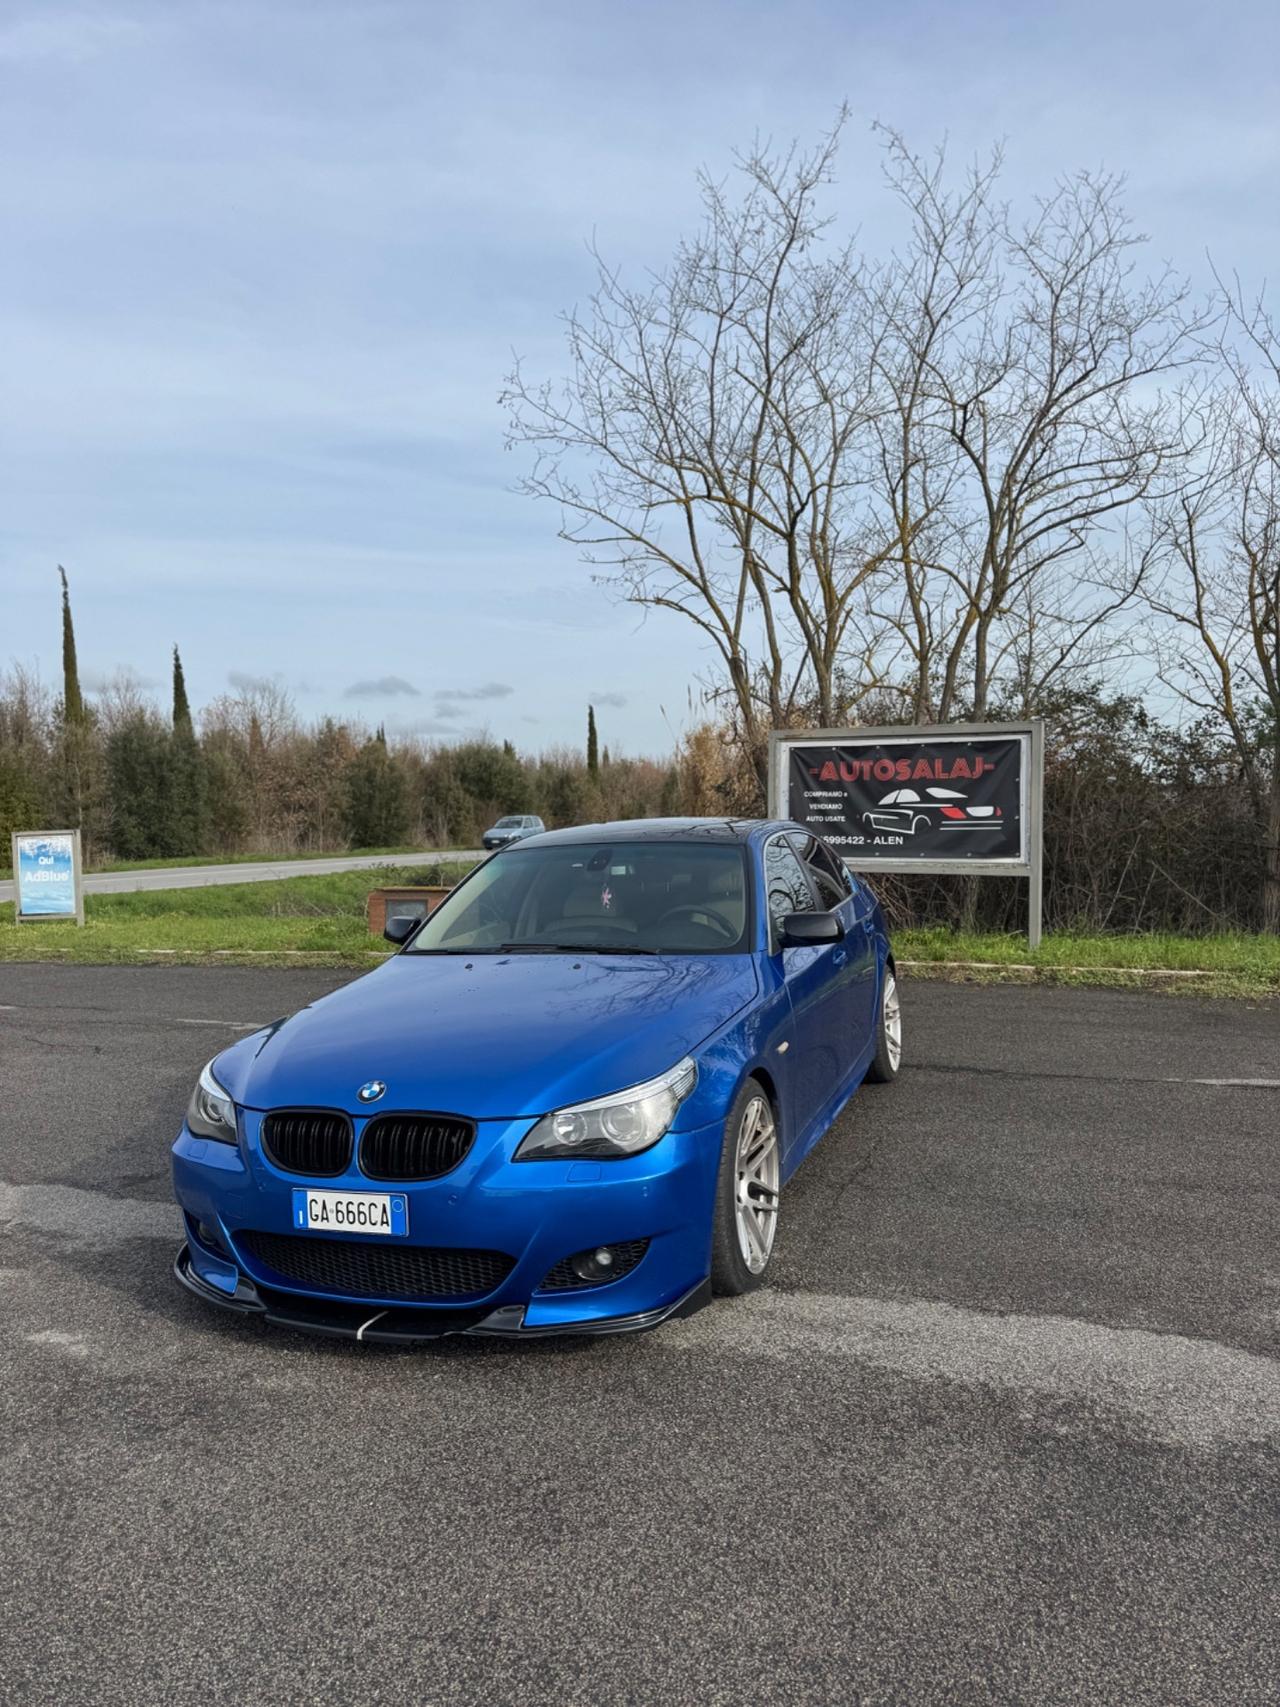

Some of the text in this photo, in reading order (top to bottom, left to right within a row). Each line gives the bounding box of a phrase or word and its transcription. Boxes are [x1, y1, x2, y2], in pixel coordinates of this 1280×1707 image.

[803, 790, 842, 798] COMPRIAMO
[873, 836, 904, 845] ALEN
[38, 856, 54, 865] Qui
